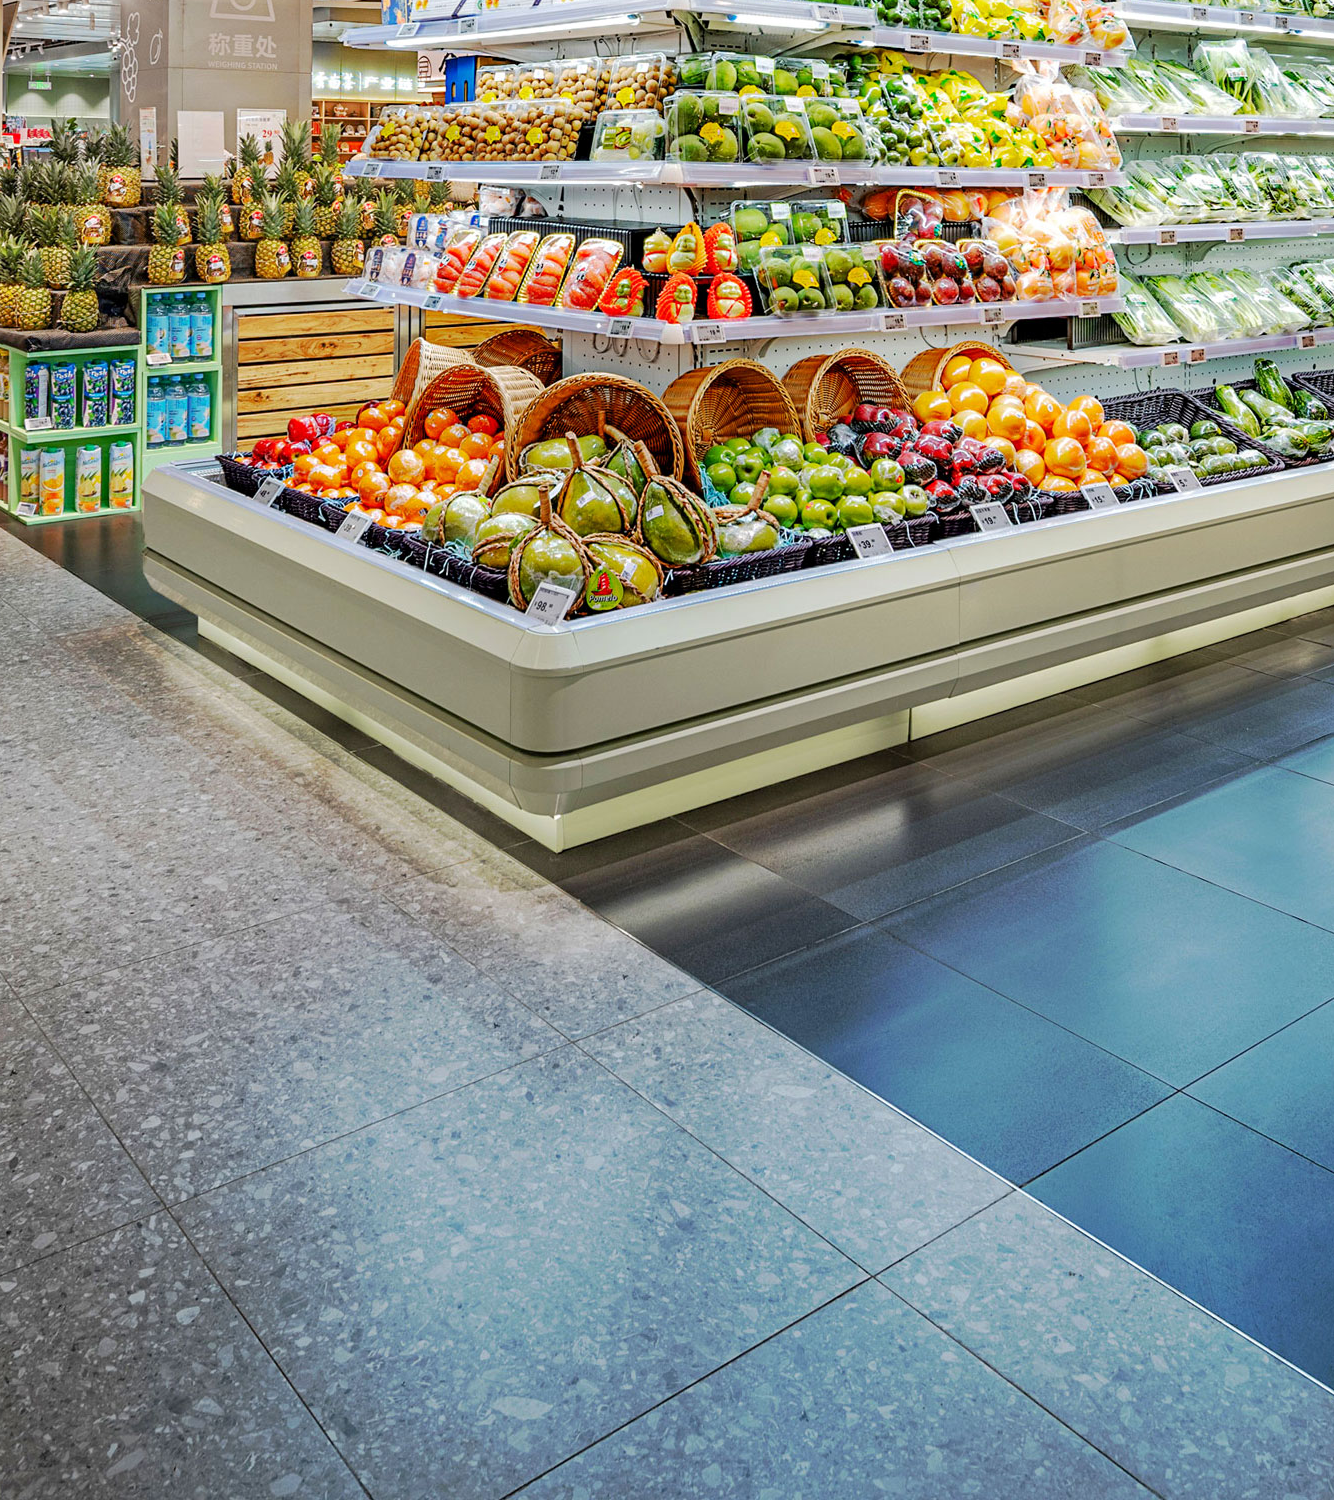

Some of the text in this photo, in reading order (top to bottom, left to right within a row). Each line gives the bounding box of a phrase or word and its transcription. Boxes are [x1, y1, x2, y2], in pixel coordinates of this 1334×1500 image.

[208, 32, 277, 59] 称重处
[208, 60, 278, 70] WEIGHING STATION
[588, 593, 619, 605] Pomelo
